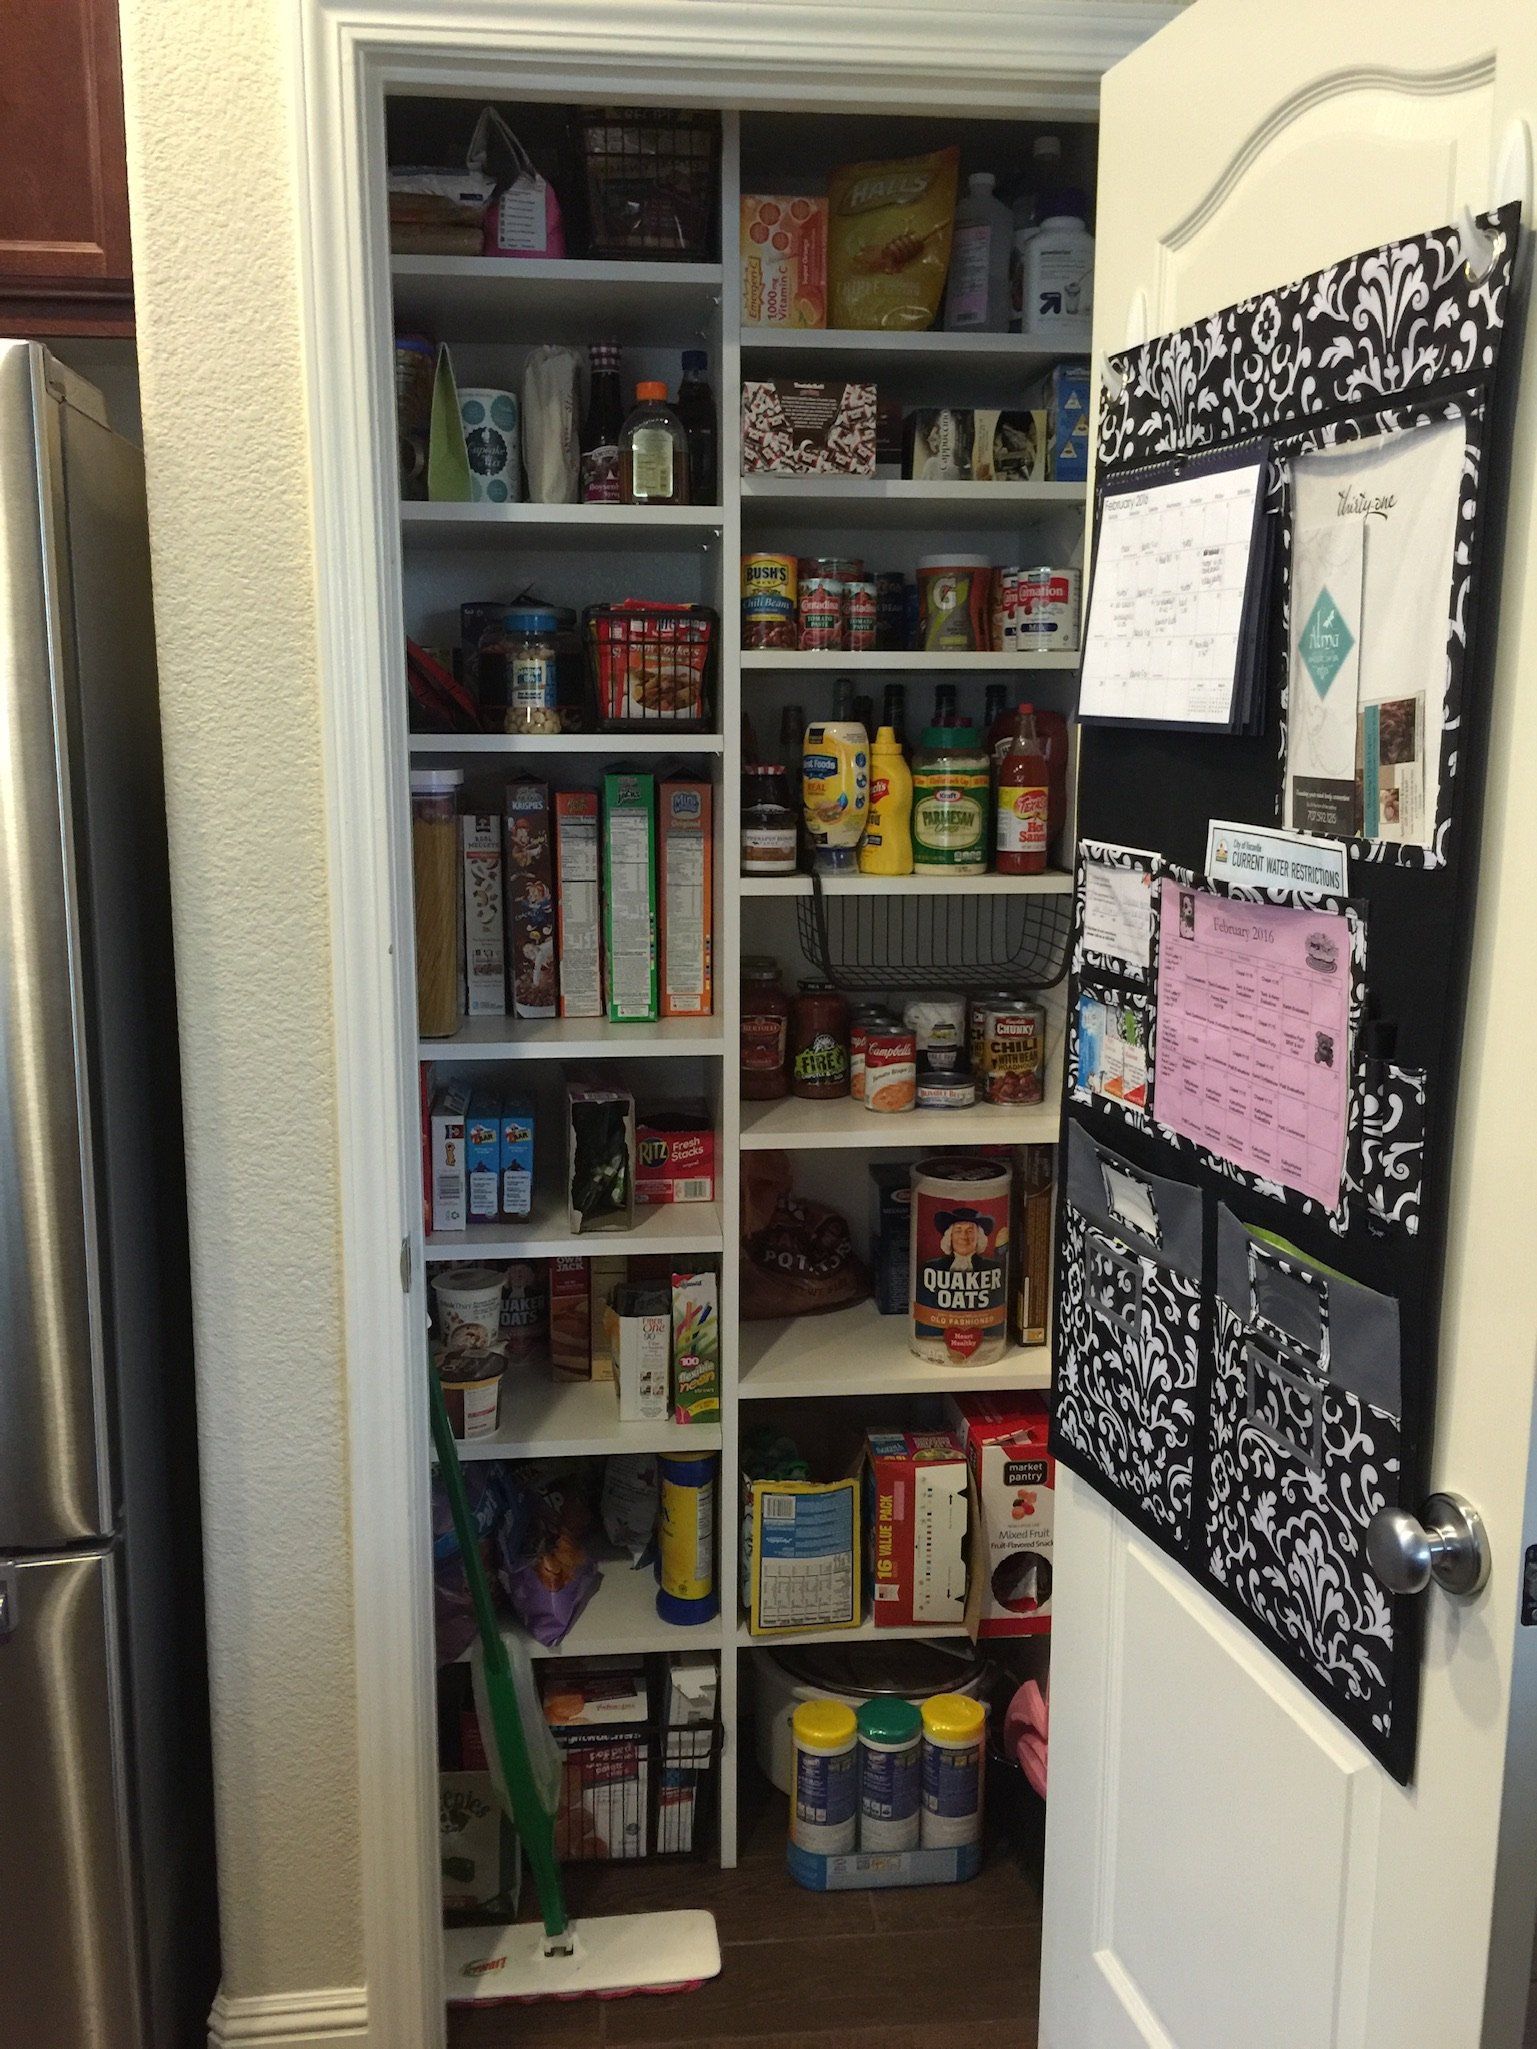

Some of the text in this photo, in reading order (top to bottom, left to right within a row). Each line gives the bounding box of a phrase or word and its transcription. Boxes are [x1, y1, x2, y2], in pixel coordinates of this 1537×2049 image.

[779, 265, 789, 320] Vitamin C
[1336, 484, 1398, 520] thirty-one
[746, 567, 786, 581] BUSH'S
[933, 577, 957, 610] G
[769, 597, 791, 610] Beans
[814, 759, 837, 770] Foods
[939, 792, 957, 800] Kraft
[922, 811, 975, 827] PARMESAN
[1233, 839, 1241, 849] City
[1231, 850, 1340, 889] CURRENT WATER RESTRICTIONS
[1213, 916, 1275, 944] February 2016
[996, 1024, 1035, 1037] CHUNKY
[868, 1041, 912, 1060] Campbell's
[990, 1039, 1038, 1055] CHILI
[672, 1136, 701, 1152] Fresh
[639, 1140, 670, 1166] RITZ
[670, 1146, 704, 1163] Stacks
[922, 1265, 1002, 1294] QUAKER
[937, 1288, 990, 1311] OATS
[928, 1314, 995, 1326] OLD FASHIONED
[680, 1355, 700, 1367] 100
[678, 1371, 716, 1393] neon
[1008, 1463, 1043, 1473] market
[1008, 1473, 1043, 1484] pantry
[877, 1494, 893, 1580] 16 VALUE PACK
[999, 1529, 1050, 1541] Mixed Fruit
